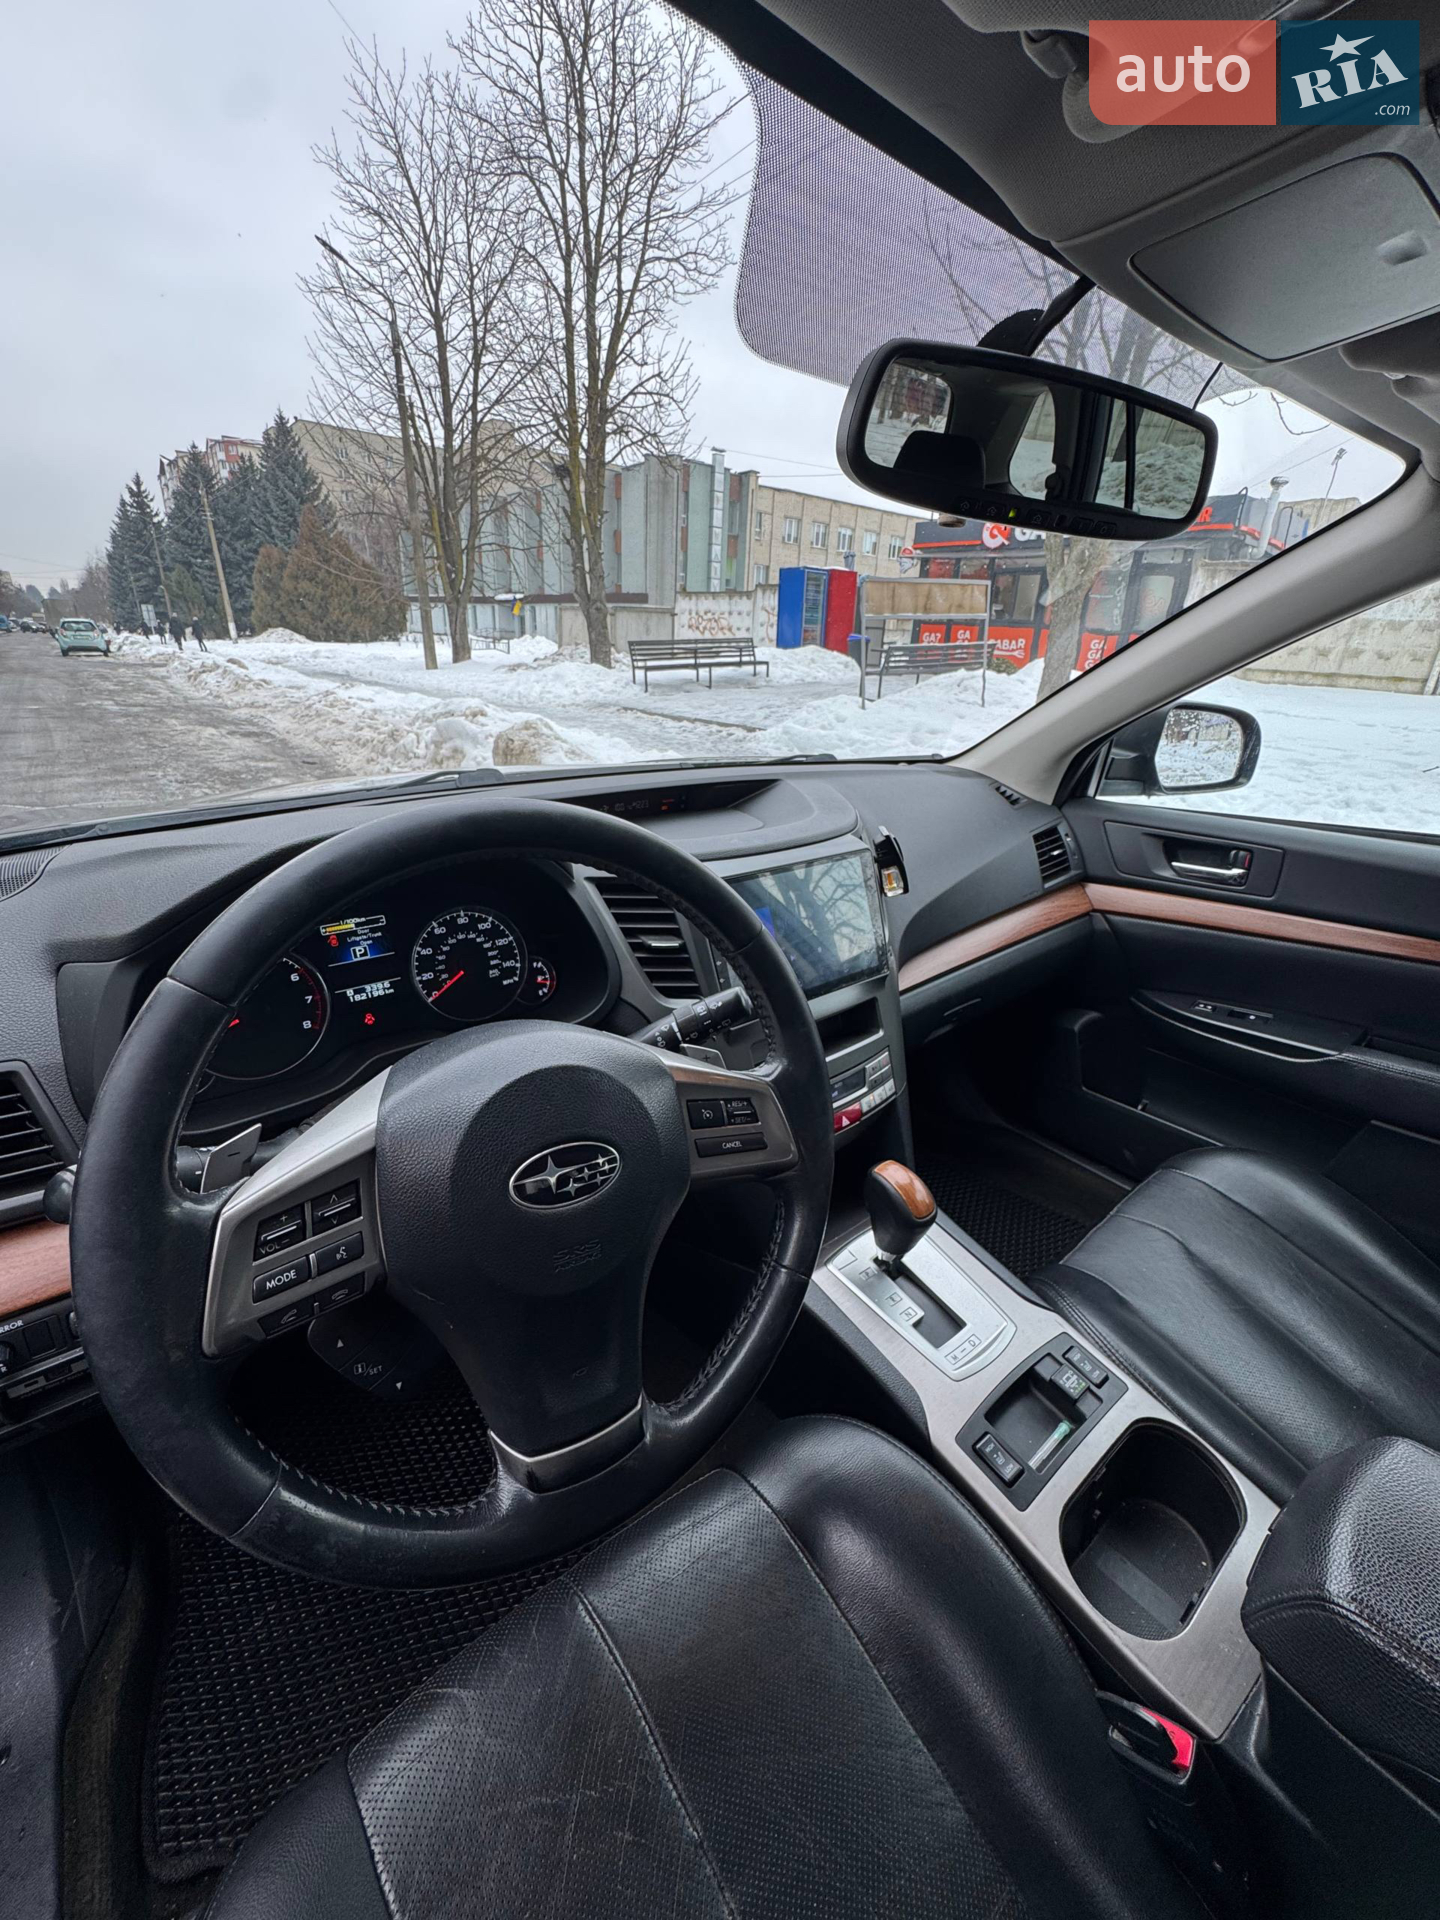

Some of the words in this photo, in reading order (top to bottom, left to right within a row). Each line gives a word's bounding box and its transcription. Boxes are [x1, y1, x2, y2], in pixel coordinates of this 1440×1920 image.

[457, 916, 469, 925] 80
[434, 926, 446, 935] 60
[478, 922, 492, 930] 100
[495, 937, 509, 946] 120
[355, 947, 365, 958] P
[420, 947, 433, 955] 40
[502, 960, 516, 968] 140
[290, 973, 300, 982] 6
[421, 972, 434, 980] 20
[304, 995, 313, 1004] 7
[302, 1020, 312, 1029] 8
[722, 1140, 742, 1149] CANCEL
[259, 1242, 281, 1254] VOL
[266, 1269, 297, 1290] MODE
